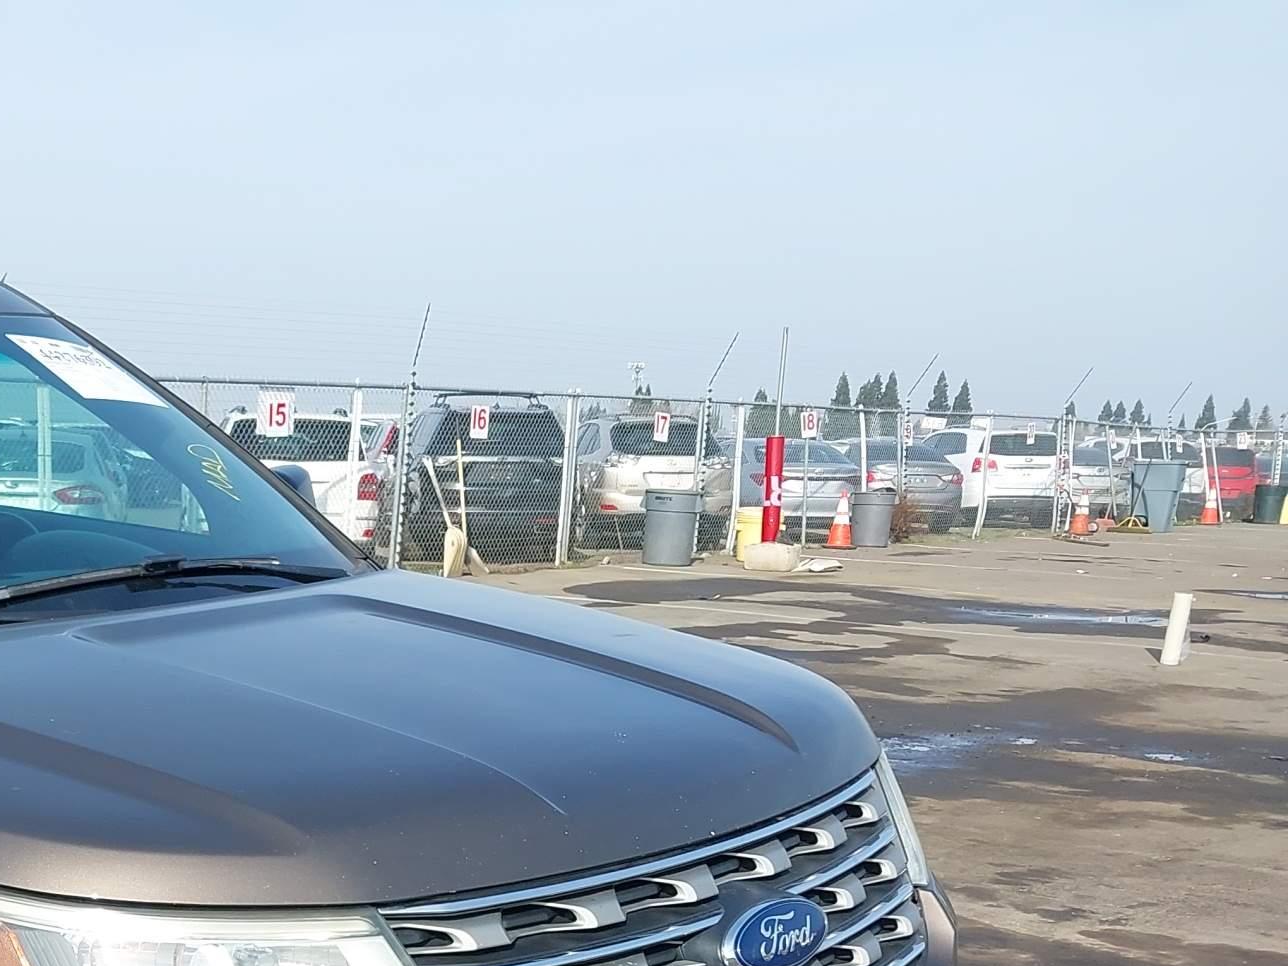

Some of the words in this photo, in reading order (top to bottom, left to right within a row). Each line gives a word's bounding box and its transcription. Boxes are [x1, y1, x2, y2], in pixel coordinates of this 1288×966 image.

[269, 402, 286, 427] 15
[472, 407, 487, 430] 16
[655, 414, 668, 434] 17
[802, 413, 815, 432] 18
[760, 910, 816, 961] Ford
